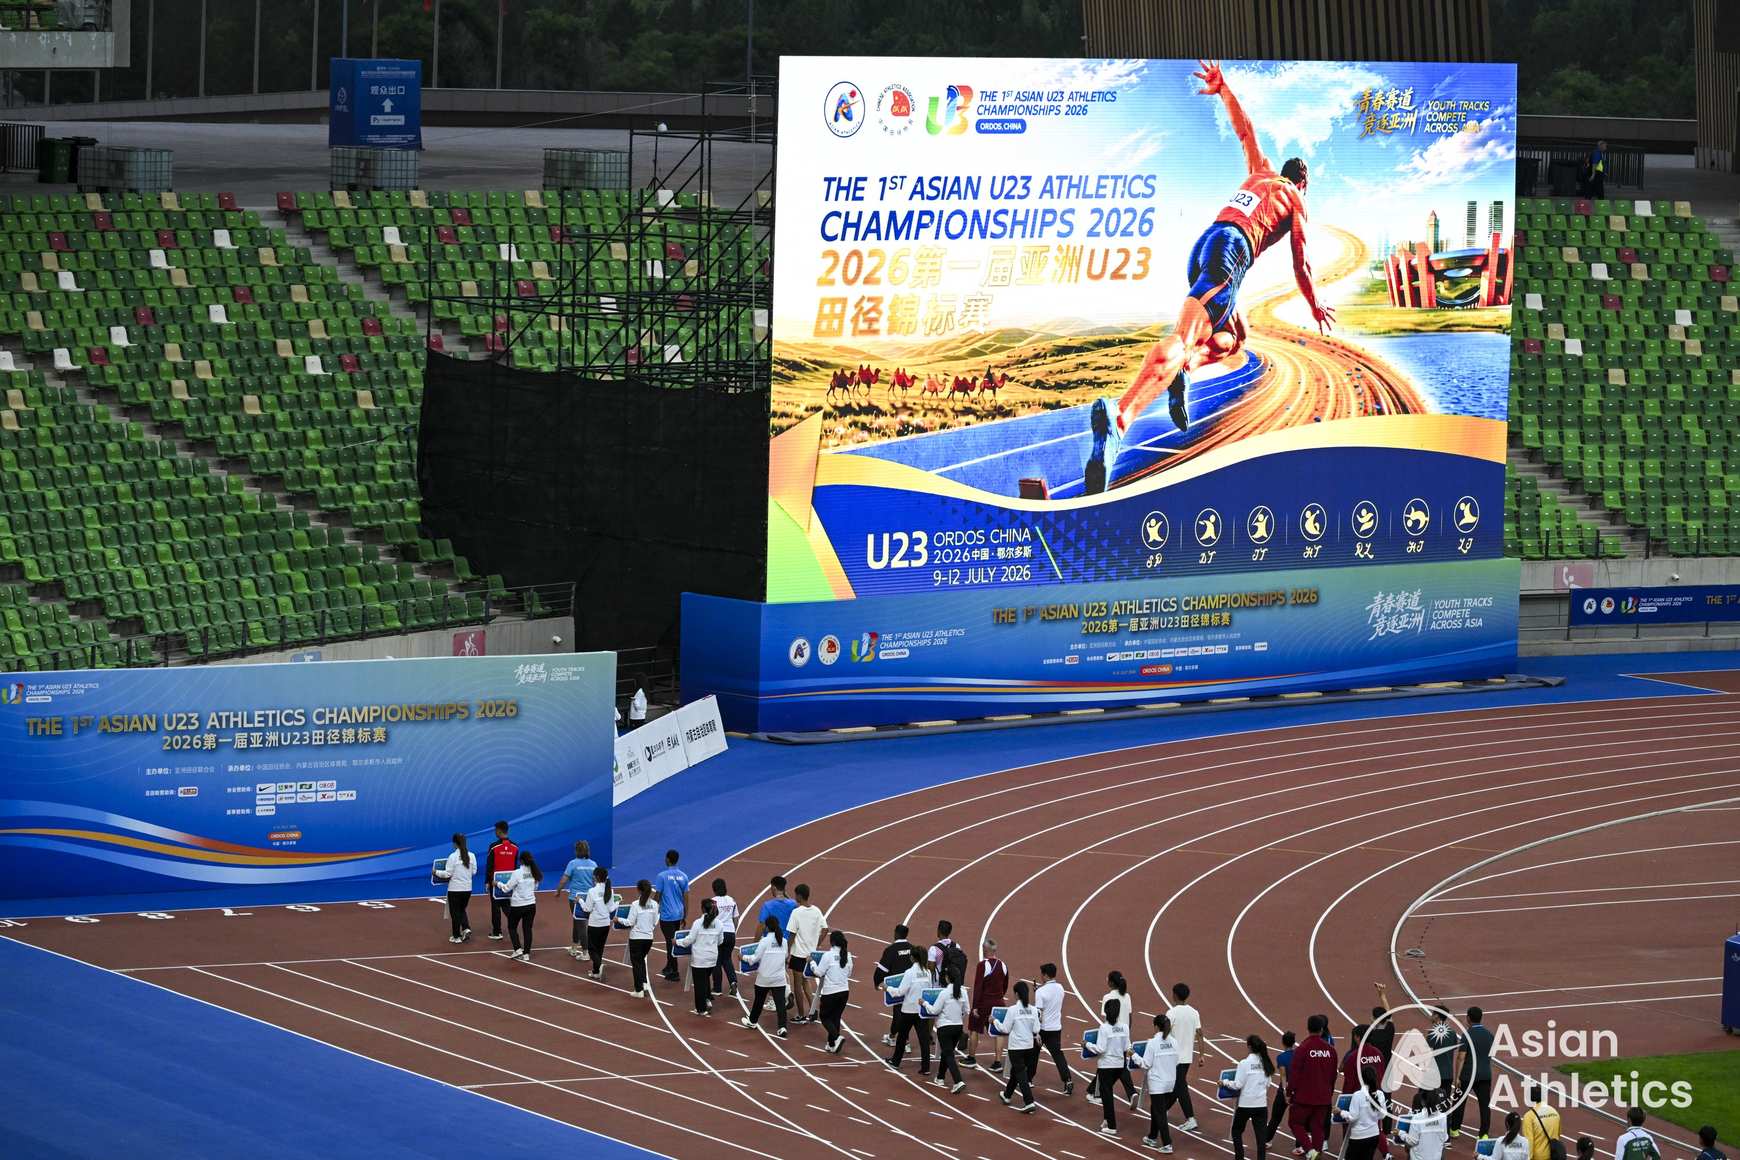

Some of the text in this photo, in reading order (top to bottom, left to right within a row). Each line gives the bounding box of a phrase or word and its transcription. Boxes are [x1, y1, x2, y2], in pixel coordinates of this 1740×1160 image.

[980, 90, 1117, 102] THE 1ST ASIAN U23 ATHLETICS
[976, 104, 1089, 116] CHAMPIONSHIPS 2026
[1428, 100, 1490, 111] YOUTH TRACKS
[1426, 111, 1467, 122] COMPETE
[1423, 122, 1459, 133] ACROSS
[822, 174, 1157, 202] THE 1ST ASIAN U23 ATHLETICS
[819, 206, 1156, 242] CHAMPIONSHIPS 2026
[815, 244, 1153, 288] 2026第一届亚洲U23
[812, 291, 994, 339] 田径锦标赛
[933, 527, 1032, 547] ORDOS CHINA
[866, 531, 929, 570] U23
[932, 564, 1032, 586] 9-12 JULY 2026
[992, 607, 1017, 624] THE
[1040, 604, 1079, 621] ASIAN
[1083, 601, 1107, 617] U23
[1112, 598, 1178, 617] ATHLETICS
[1181, 590, 1287, 611] CHAMPIONSHIPS
[1290, 588, 1319, 604] 2026
[1433, 597, 1494, 610] YOUTH TRACKS
[1706, 595, 1722, 605] THE
[1432, 608, 1471, 620] COMPETE
[1430, 617, 1483, 631] ACROSS ASIA
[881, 633, 893, 642] THE
[902, 632, 921, 640] ASIAN
[934, 628, 966, 638] ATHLETICS
[879, 638, 931, 650] CHAMPIONSHIPS
[26, 717, 63, 736] THE
[97, 714, 157, 733] ASIAN
[163, 712, 200, 731] U23
[206, 709, 306, 730] ATHLETICS
[312, 702, 469, 726] CHAMPIONSHIPS
[475, 700, 519, 719] 2026
[162, 726, 389, 751] 2026第一届亚洲U23田径锦标赛
[357, 901, 397, 909] 5
[137, 912, 175, 920] 8
[221, 908, 253, 917] 7
[1309, 1049, 1331, 1059] CHINA
[1360, 1055, 1382, 1065] CHINA
